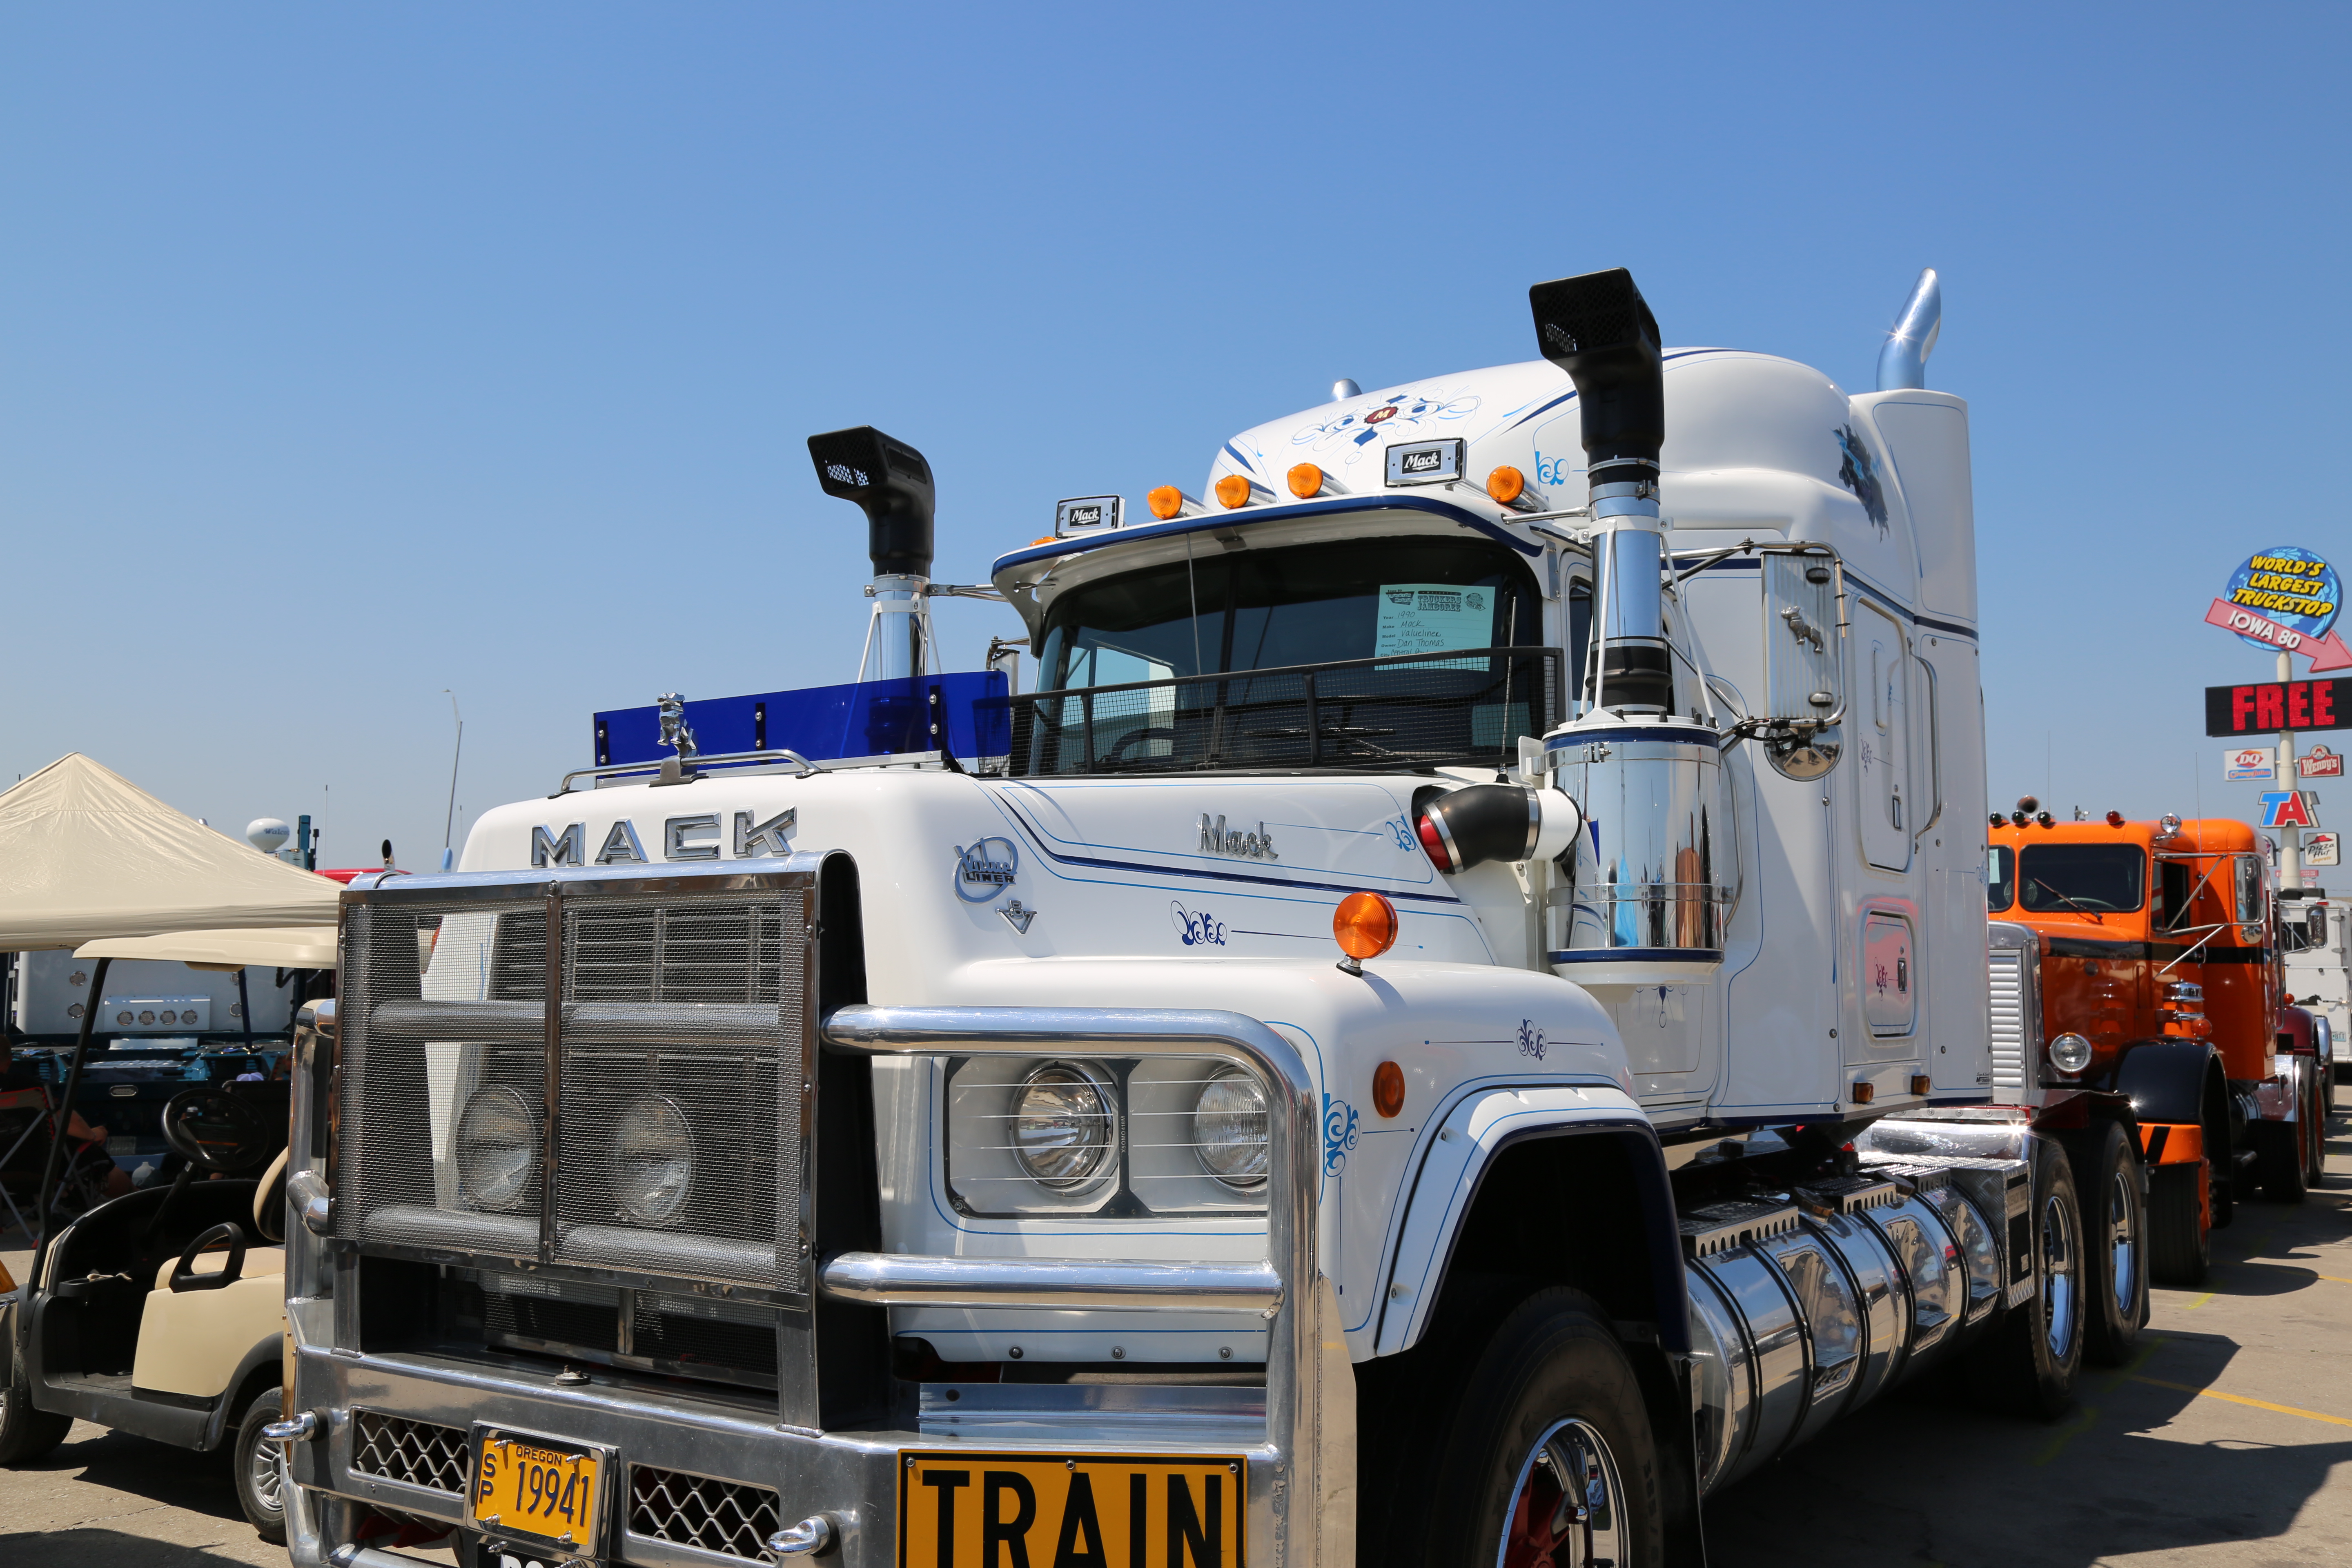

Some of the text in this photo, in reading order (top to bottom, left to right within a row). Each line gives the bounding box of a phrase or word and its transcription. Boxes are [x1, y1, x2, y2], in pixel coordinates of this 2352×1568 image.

[1404, 452, 1439, 470] Mack
[1071, 508, 1099, 524] Mack
[2250, 555, 2325, 576] WORLD'S
[2249, 573, 2324, 595] LARGEST
[1417, 603, 1461, 612] JAMBOREE
[1418, 595, 1462, 604] TRUCKERS
[2232, 589, 2333, 616] TRUCKSTOP
[1398, 610, 1415, 619] 1990
[2228, 610, 2301, 649] IOWA 80
[1397, 639, 1412, 648] Dan
[1416, 638, 1444, 647] Thomas
[2232, 680, 2335, 731] FREE
[2239, 753, 2261, 765] DQ
[2260, 791, 2310, 826] TA
[531, 805, 797, 869] MACK
[1196, 813, 1279, 861] Mack
[953, 837, 1017, 874] Value
[2308, 844, 2334, 856] Pizza
[2313, 849, 2332, 859] Hut
[963, 871, 1016, 886] LINER
[516, 1446, 563, 1466] OREGON
[515, 1461, 589, 1527] 19941
[922, 1469, 1222, 1568] TRAIN
